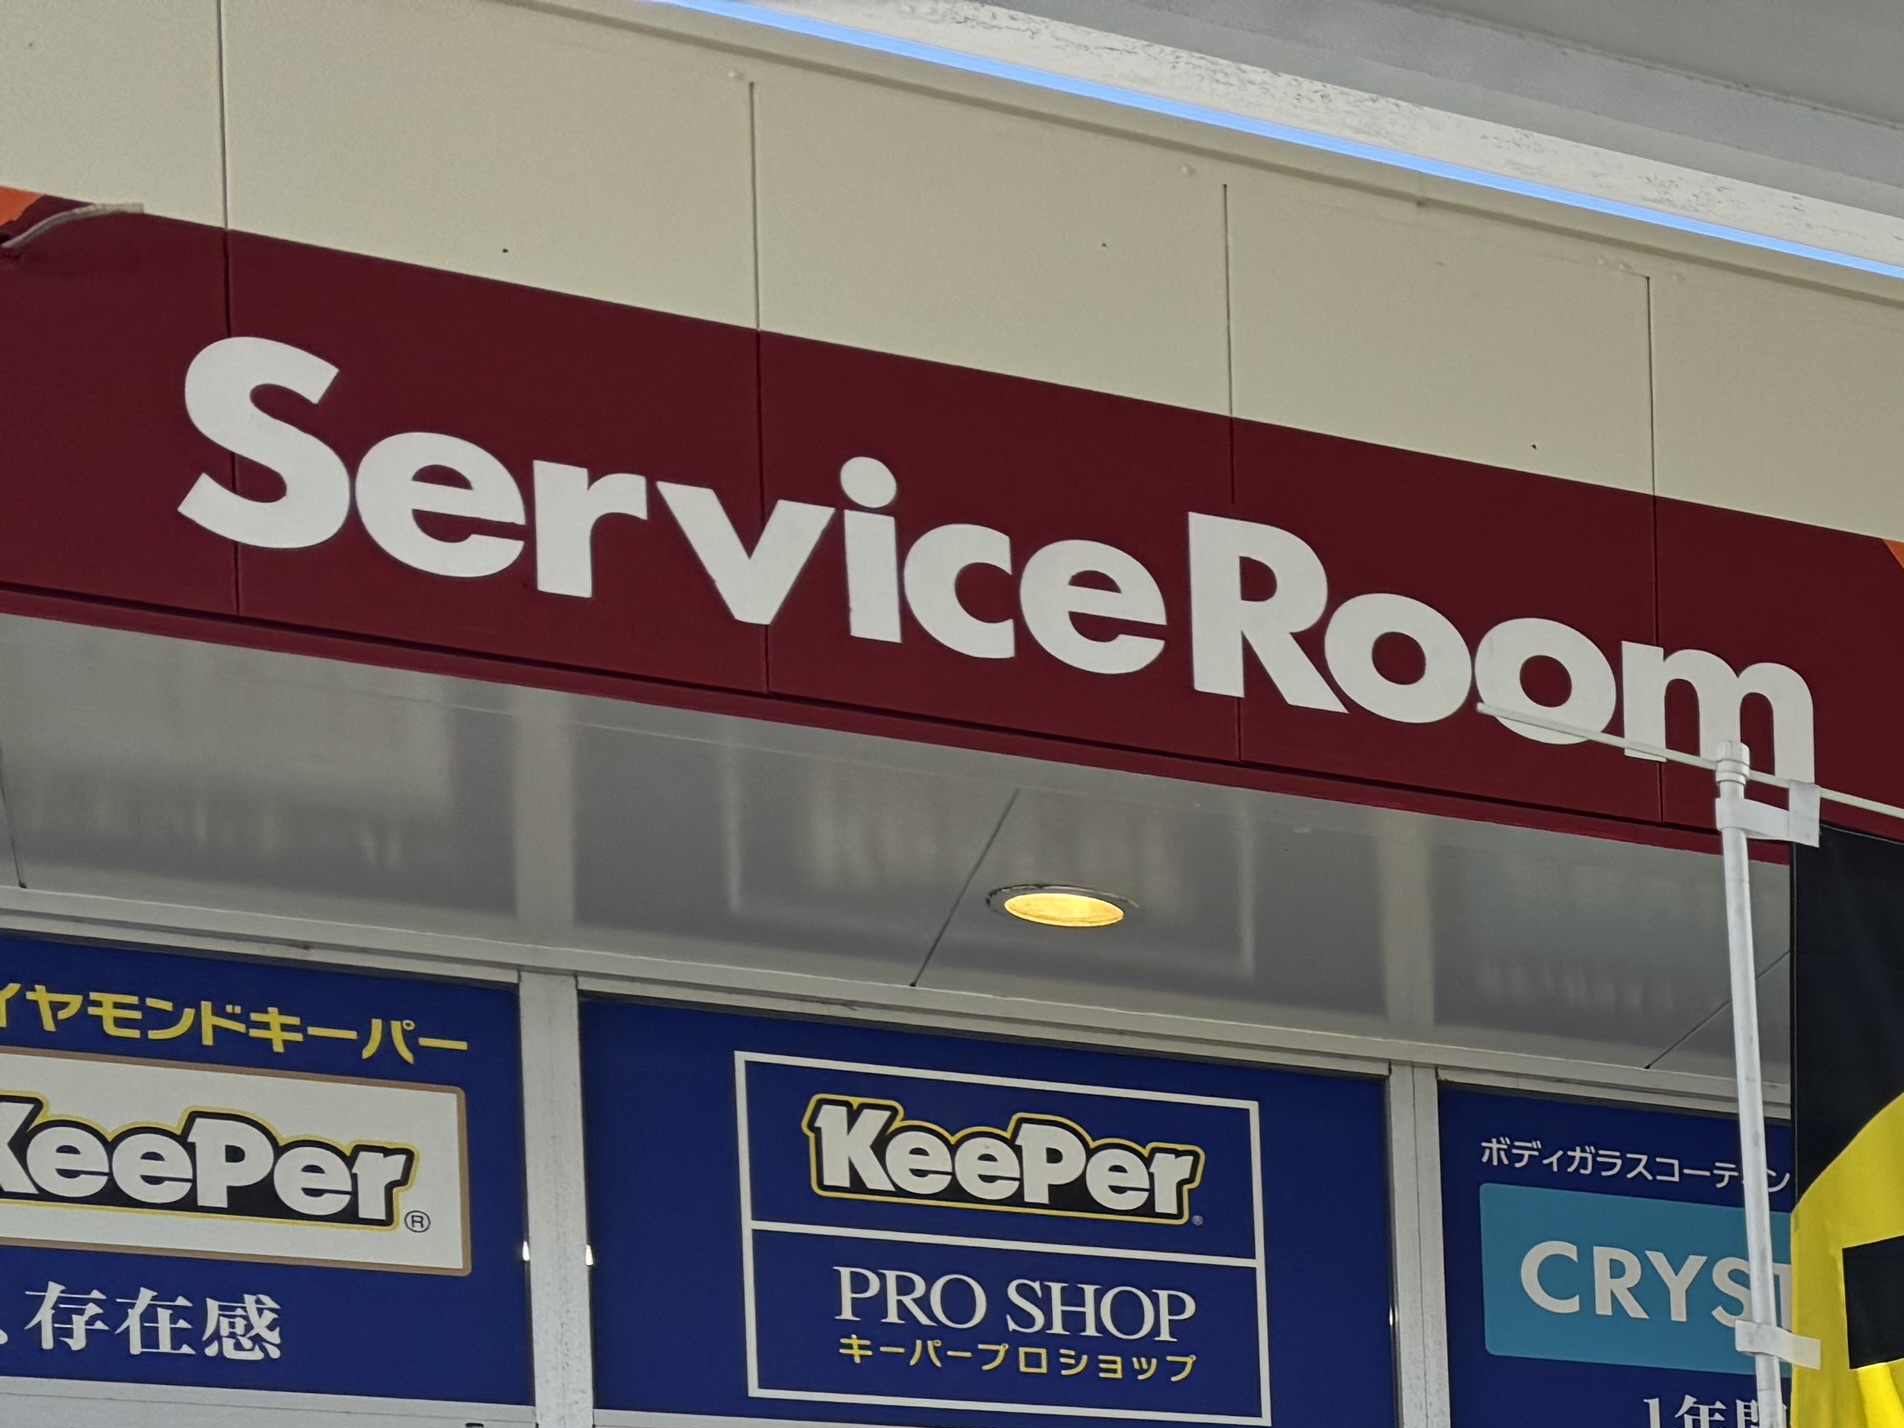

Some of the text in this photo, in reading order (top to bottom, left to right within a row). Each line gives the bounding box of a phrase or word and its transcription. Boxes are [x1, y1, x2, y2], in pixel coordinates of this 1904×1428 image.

[813, 1103, 1195, 1216] KeePer
[1480, 1136, 1791, 1193] ボディガラスコーテン
[834, 1266, 1197, 1343] PRO SHOP
[838, 1333, 1197, 1383] キーパープロショップ
